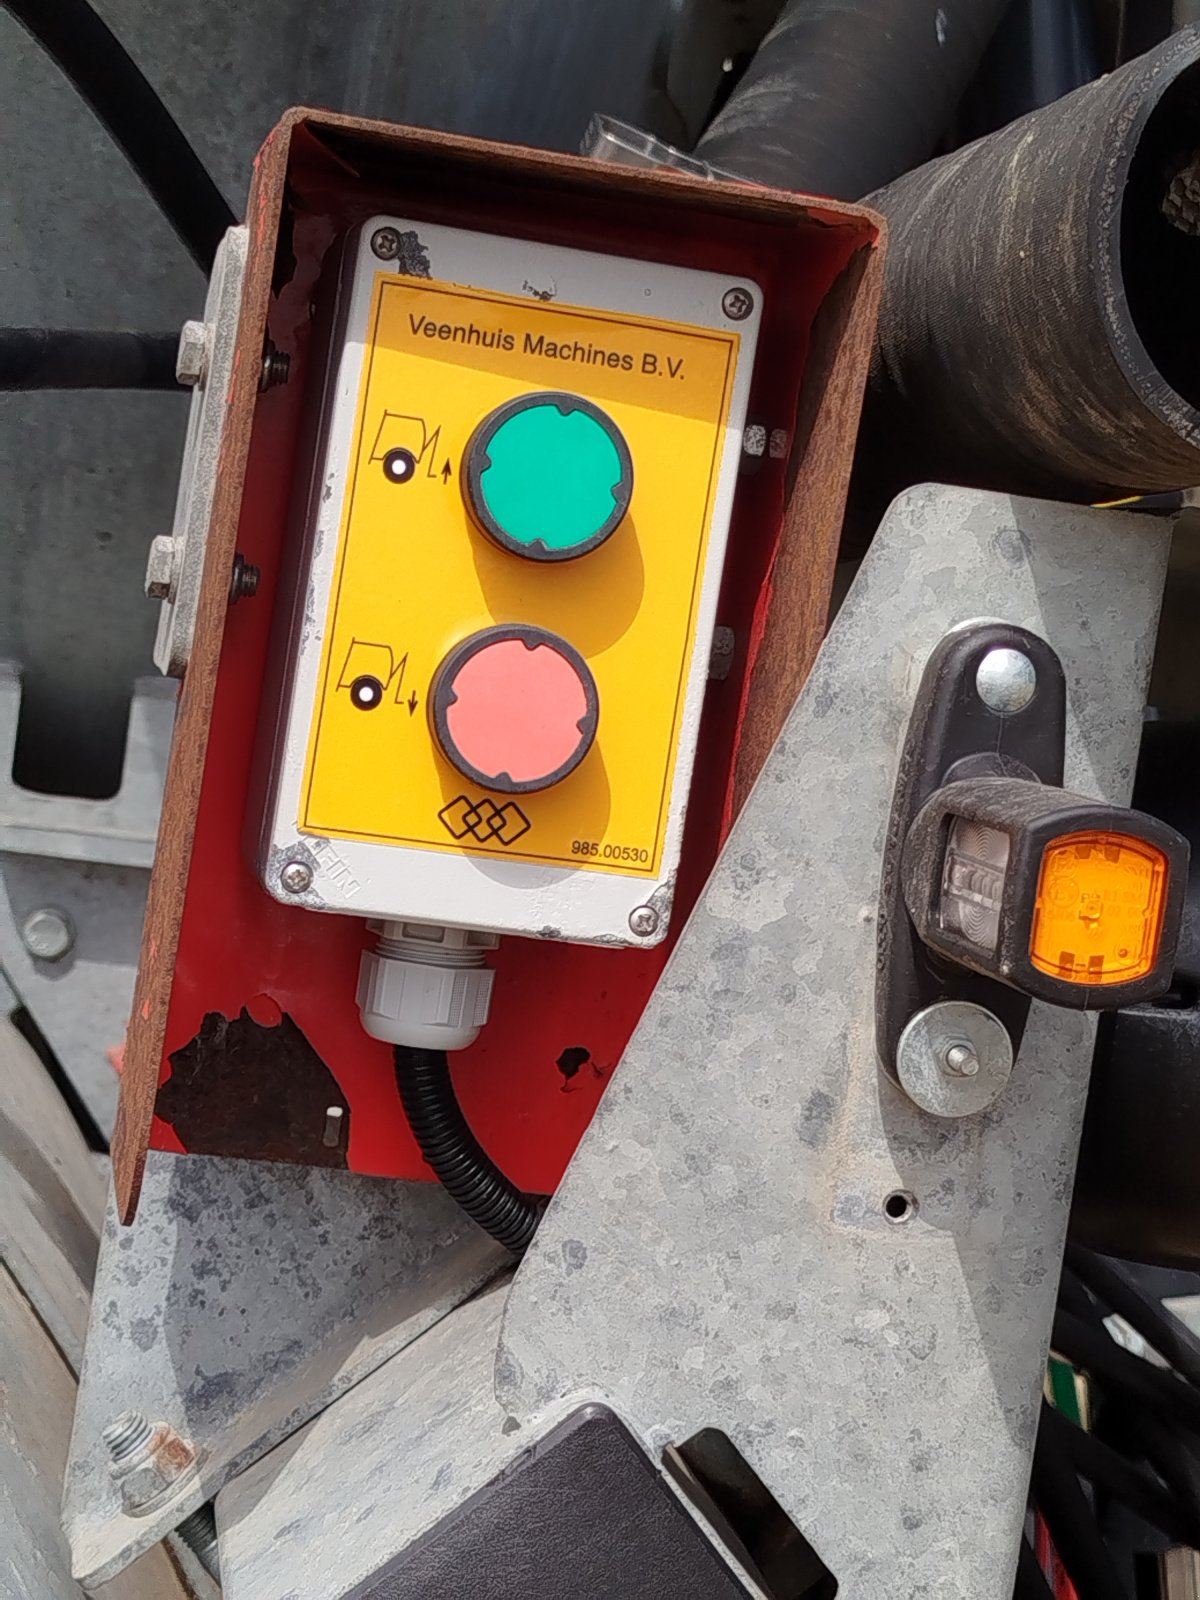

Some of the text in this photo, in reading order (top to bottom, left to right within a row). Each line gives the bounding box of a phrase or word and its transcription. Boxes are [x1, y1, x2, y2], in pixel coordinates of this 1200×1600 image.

[408, 313, 686, 380] Veenhuis Machines B.V.
[571, 840, 649, 863] 985.00530
